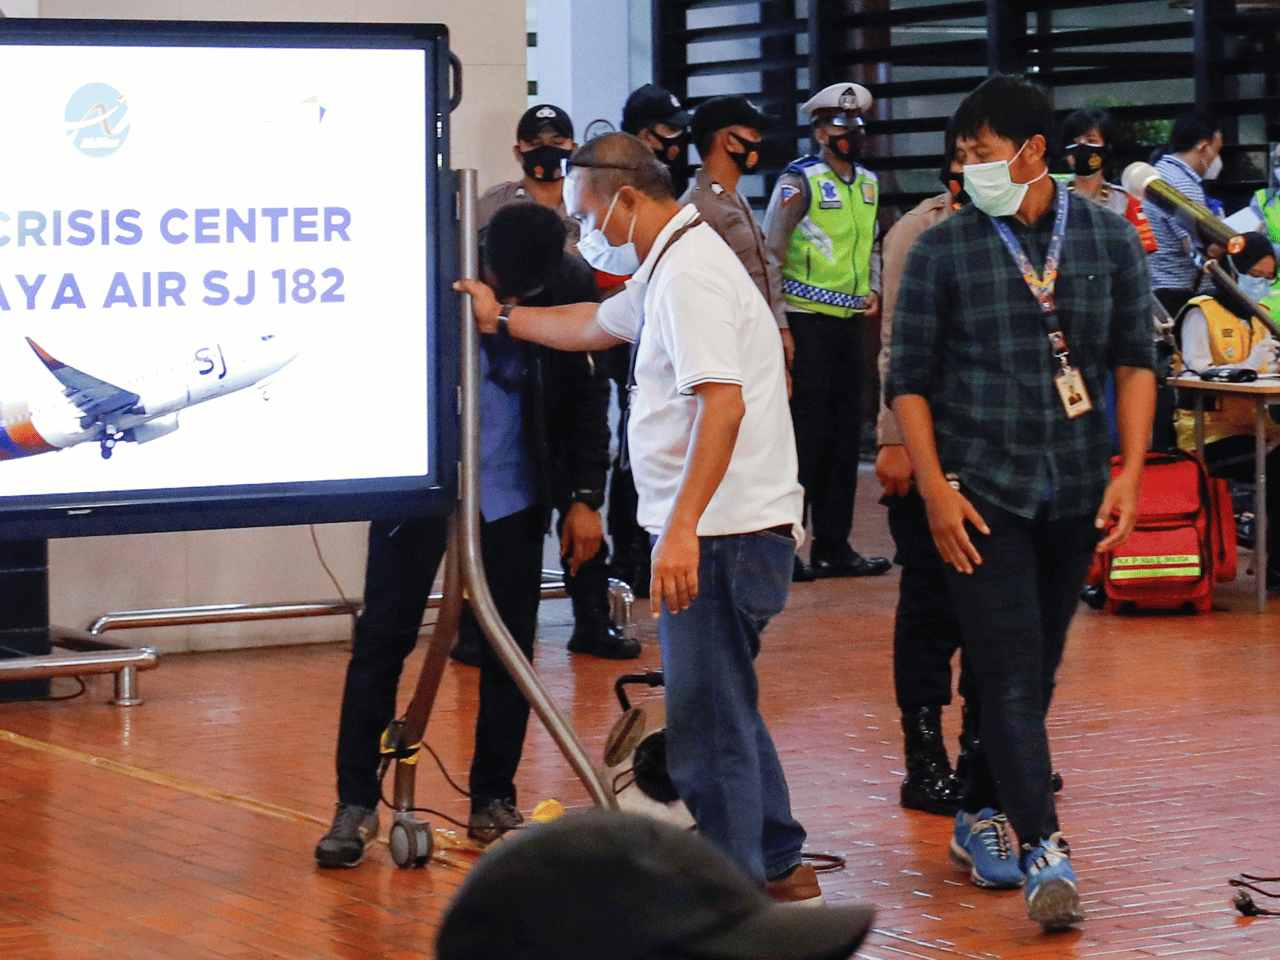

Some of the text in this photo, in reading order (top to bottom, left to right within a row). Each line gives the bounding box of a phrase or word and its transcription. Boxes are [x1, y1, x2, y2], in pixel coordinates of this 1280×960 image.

[160, 206, 352, 245] CENTER
[102, 271, 187, 308] AIR
[201, 269, 255, 306] SJ
[271, 266, 345, 304] 182
[195, 343, 227, 380] SJ
